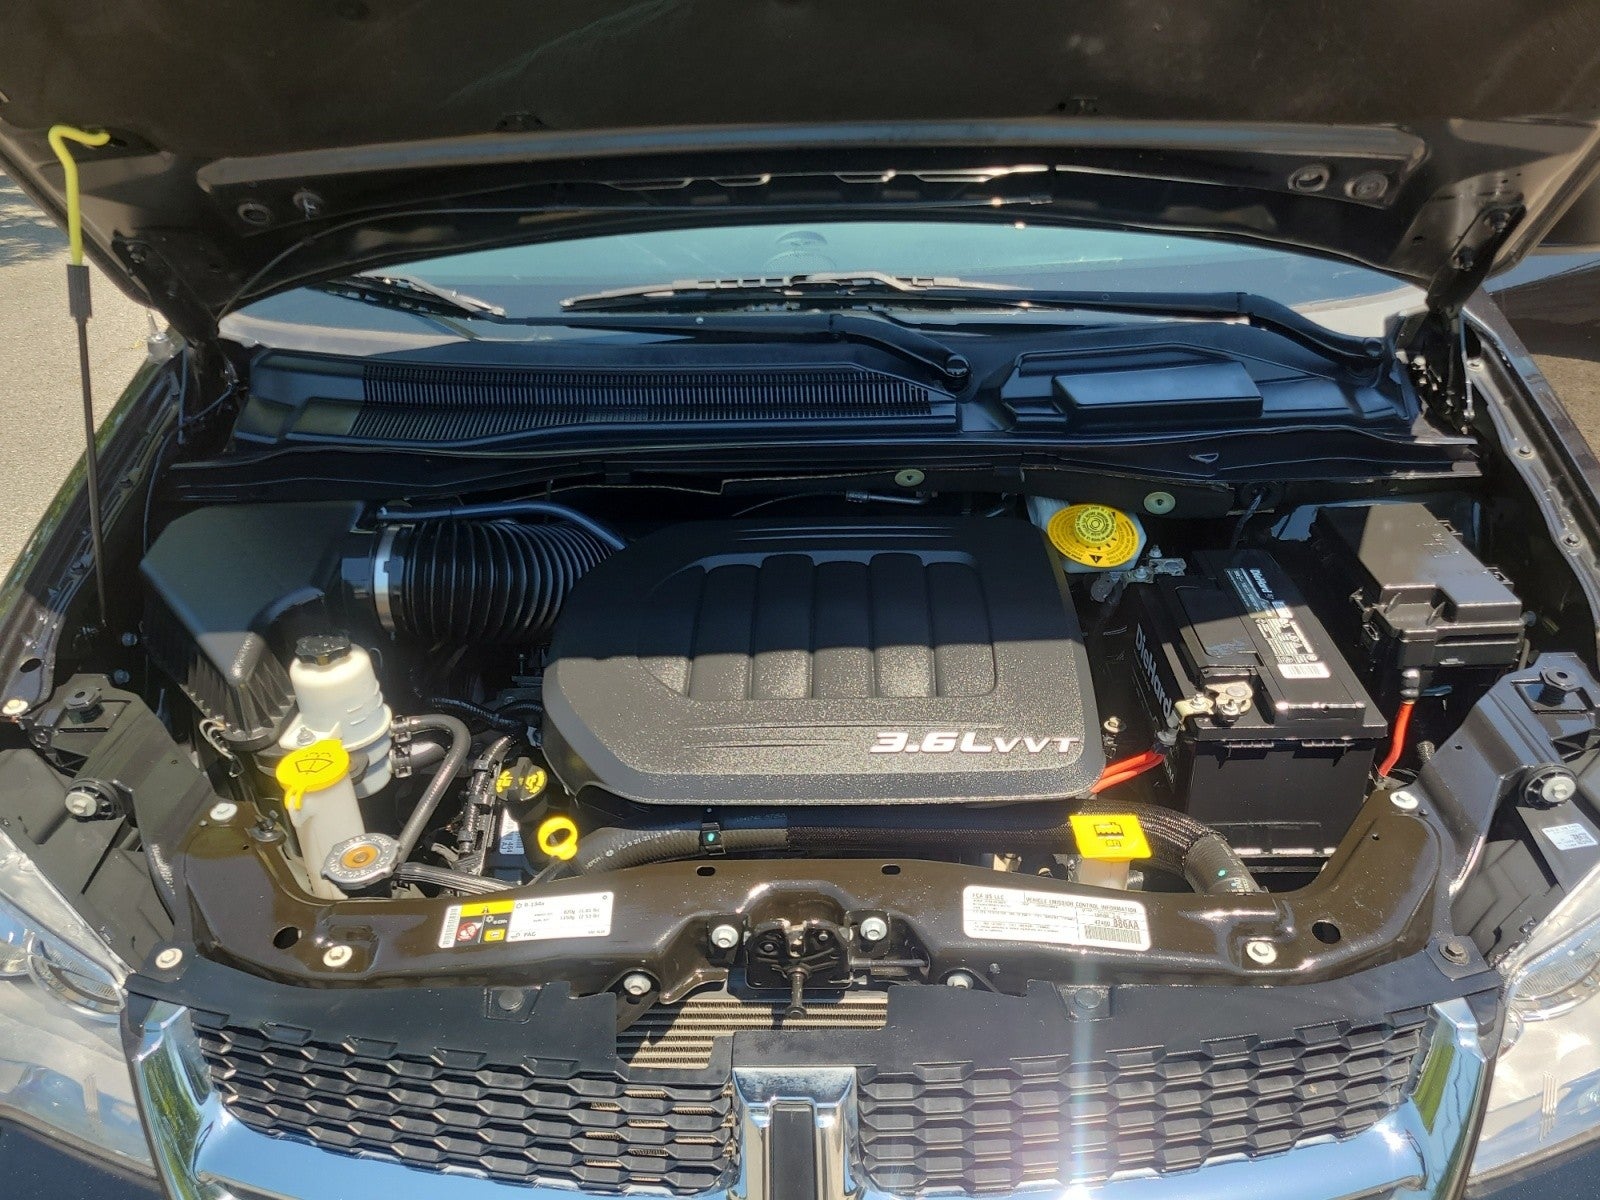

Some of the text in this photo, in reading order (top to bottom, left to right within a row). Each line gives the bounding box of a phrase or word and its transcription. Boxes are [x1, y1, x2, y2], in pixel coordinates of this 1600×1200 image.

[1135, 623, 1172, 720] DieHard
[1026, 897, 1047, 905] VEHICLE
[1048, 899, 1074, 907] EMISSION
[1075, 901, 1099, 910] CONTROL
[1100, 904, 1137, 913] INFORMATION
